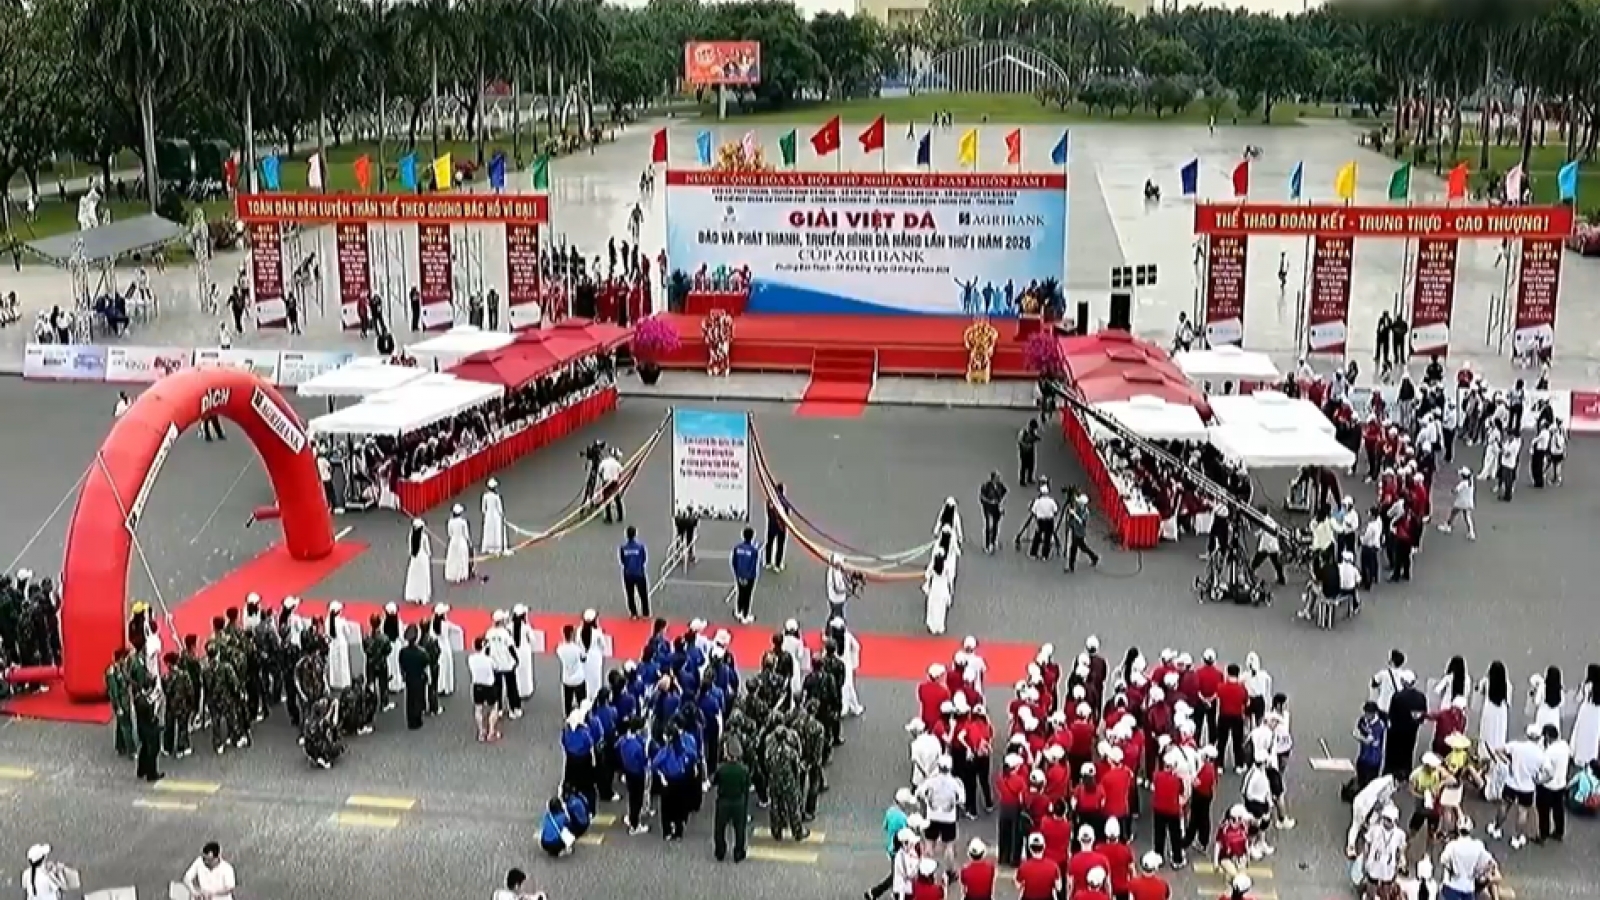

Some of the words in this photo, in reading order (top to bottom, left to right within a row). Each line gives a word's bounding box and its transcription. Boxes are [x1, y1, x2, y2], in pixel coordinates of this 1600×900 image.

[723, 173, 757, 185] CỘNG
[789, 174, 804, 185] XÃ
[808, 174, 830, 186] HỘI
[863, 175, 901, 186] NGHĨA
[907, 176, 938, 187] VIỆT
[941, 176, 967, 187] NAM
[971, 176, 1008, 187] MUÔN
[248, 198, 273, 216] TOÀN
[275, 199, 296, 216] DÂN
[352, 198, 378, 217] THÂN
[401, 201, 425, 217] THEO
[465, 199, 484, 217] BÁC
[789, 207, 838, 228] GIẢI
[845, 209, 896, 232] VIỆT
[973, 214, 1046, 226] AGRIBANK
[1215, 207, 1240, 228] THỂ
[1243, 212, 1277, 229] THAO
[1320, 209, 1346, 230] KẾT
[1359, 214, 1403, 231] TRUNG
[1407, 213, 1442, 234] THỰC
[1455, 215, 1483, 231] CAO
[721, 229, 735, 245] VÀ
[738, 230, 763, 246] PHÁT
[977, 232, 1002, 249] NĂM
[1005, 236, 1031, 250] 2026
[835, 250, 925, 263] AGRIBANK
